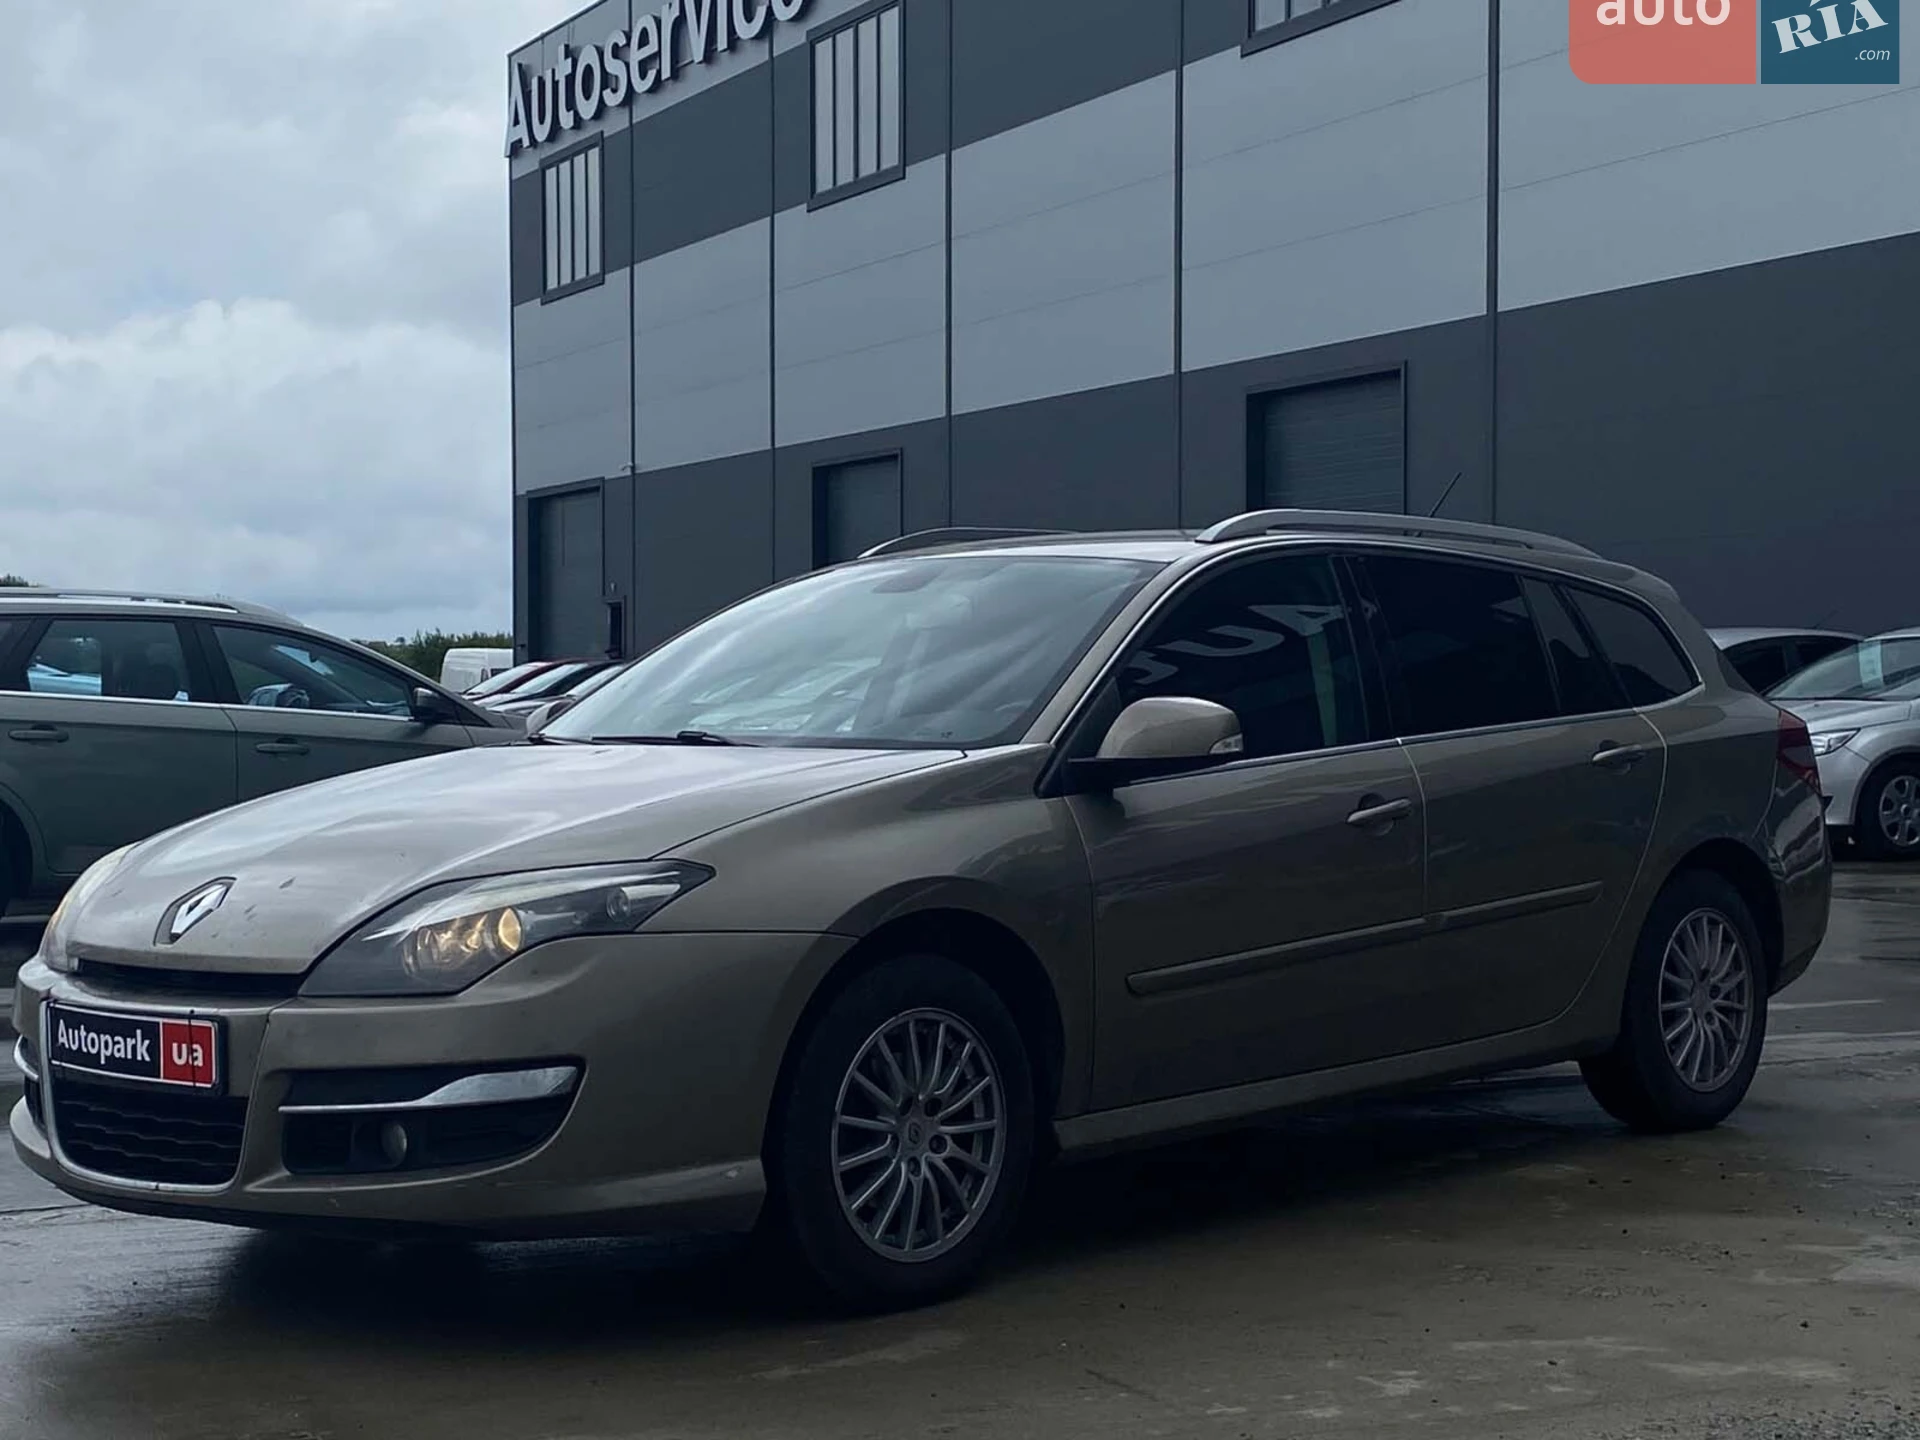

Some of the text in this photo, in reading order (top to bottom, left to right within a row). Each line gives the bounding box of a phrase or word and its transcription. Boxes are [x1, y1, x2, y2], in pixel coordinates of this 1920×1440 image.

[506, 0, 803, 148] Autoservic
[57, 1018, 204, 1067] Autopark ua
